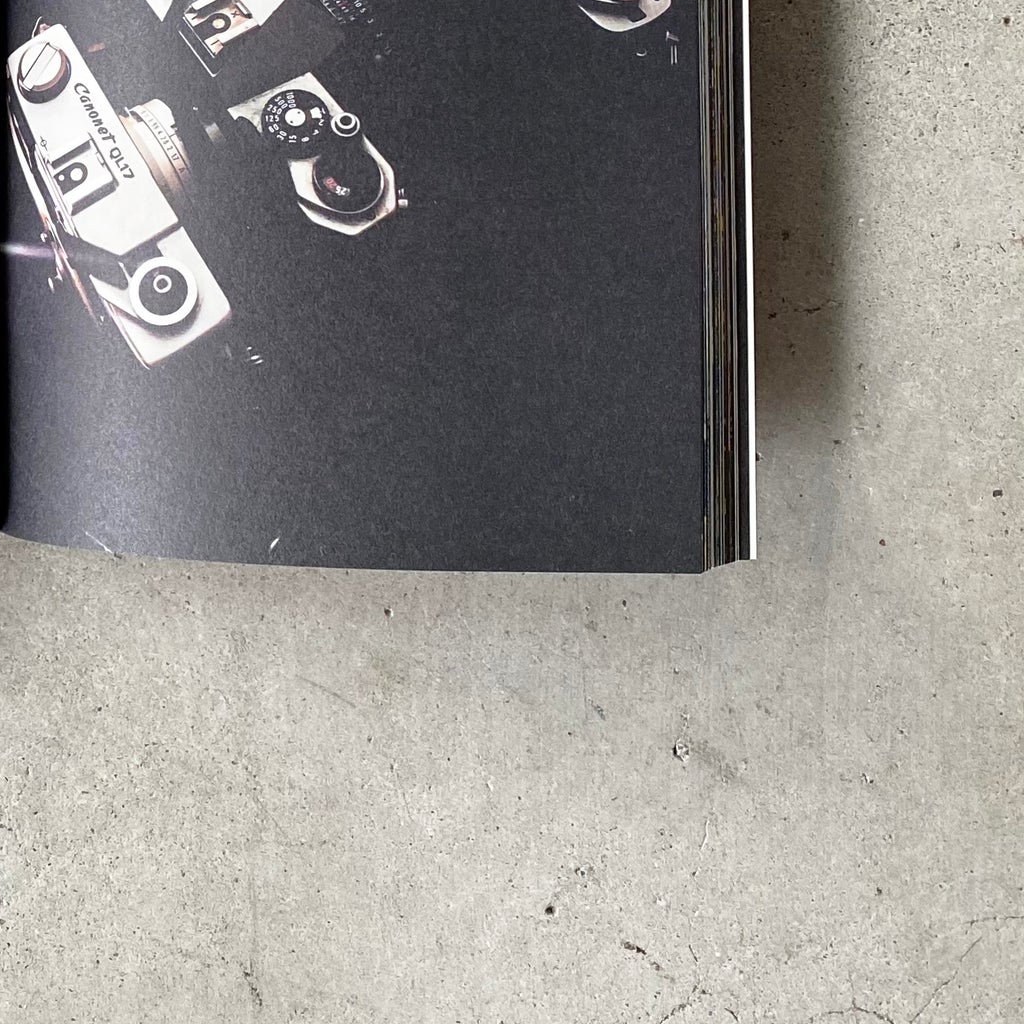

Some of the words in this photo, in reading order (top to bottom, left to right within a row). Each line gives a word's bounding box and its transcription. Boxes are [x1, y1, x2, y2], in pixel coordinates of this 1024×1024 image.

[274, 96, 288, 109] 500
[286, 91, 296, 108] 1000
[266, 104, 282, 115] 250
[265, 114, 280, 123] 125
[73, 82, 117, 144] Canonet
[108, 146, 136, 179] QL17
[268, 123, 279, 133] 60
[276, 130, 287, 141] 30
[288, 134, 297, 143] 15
